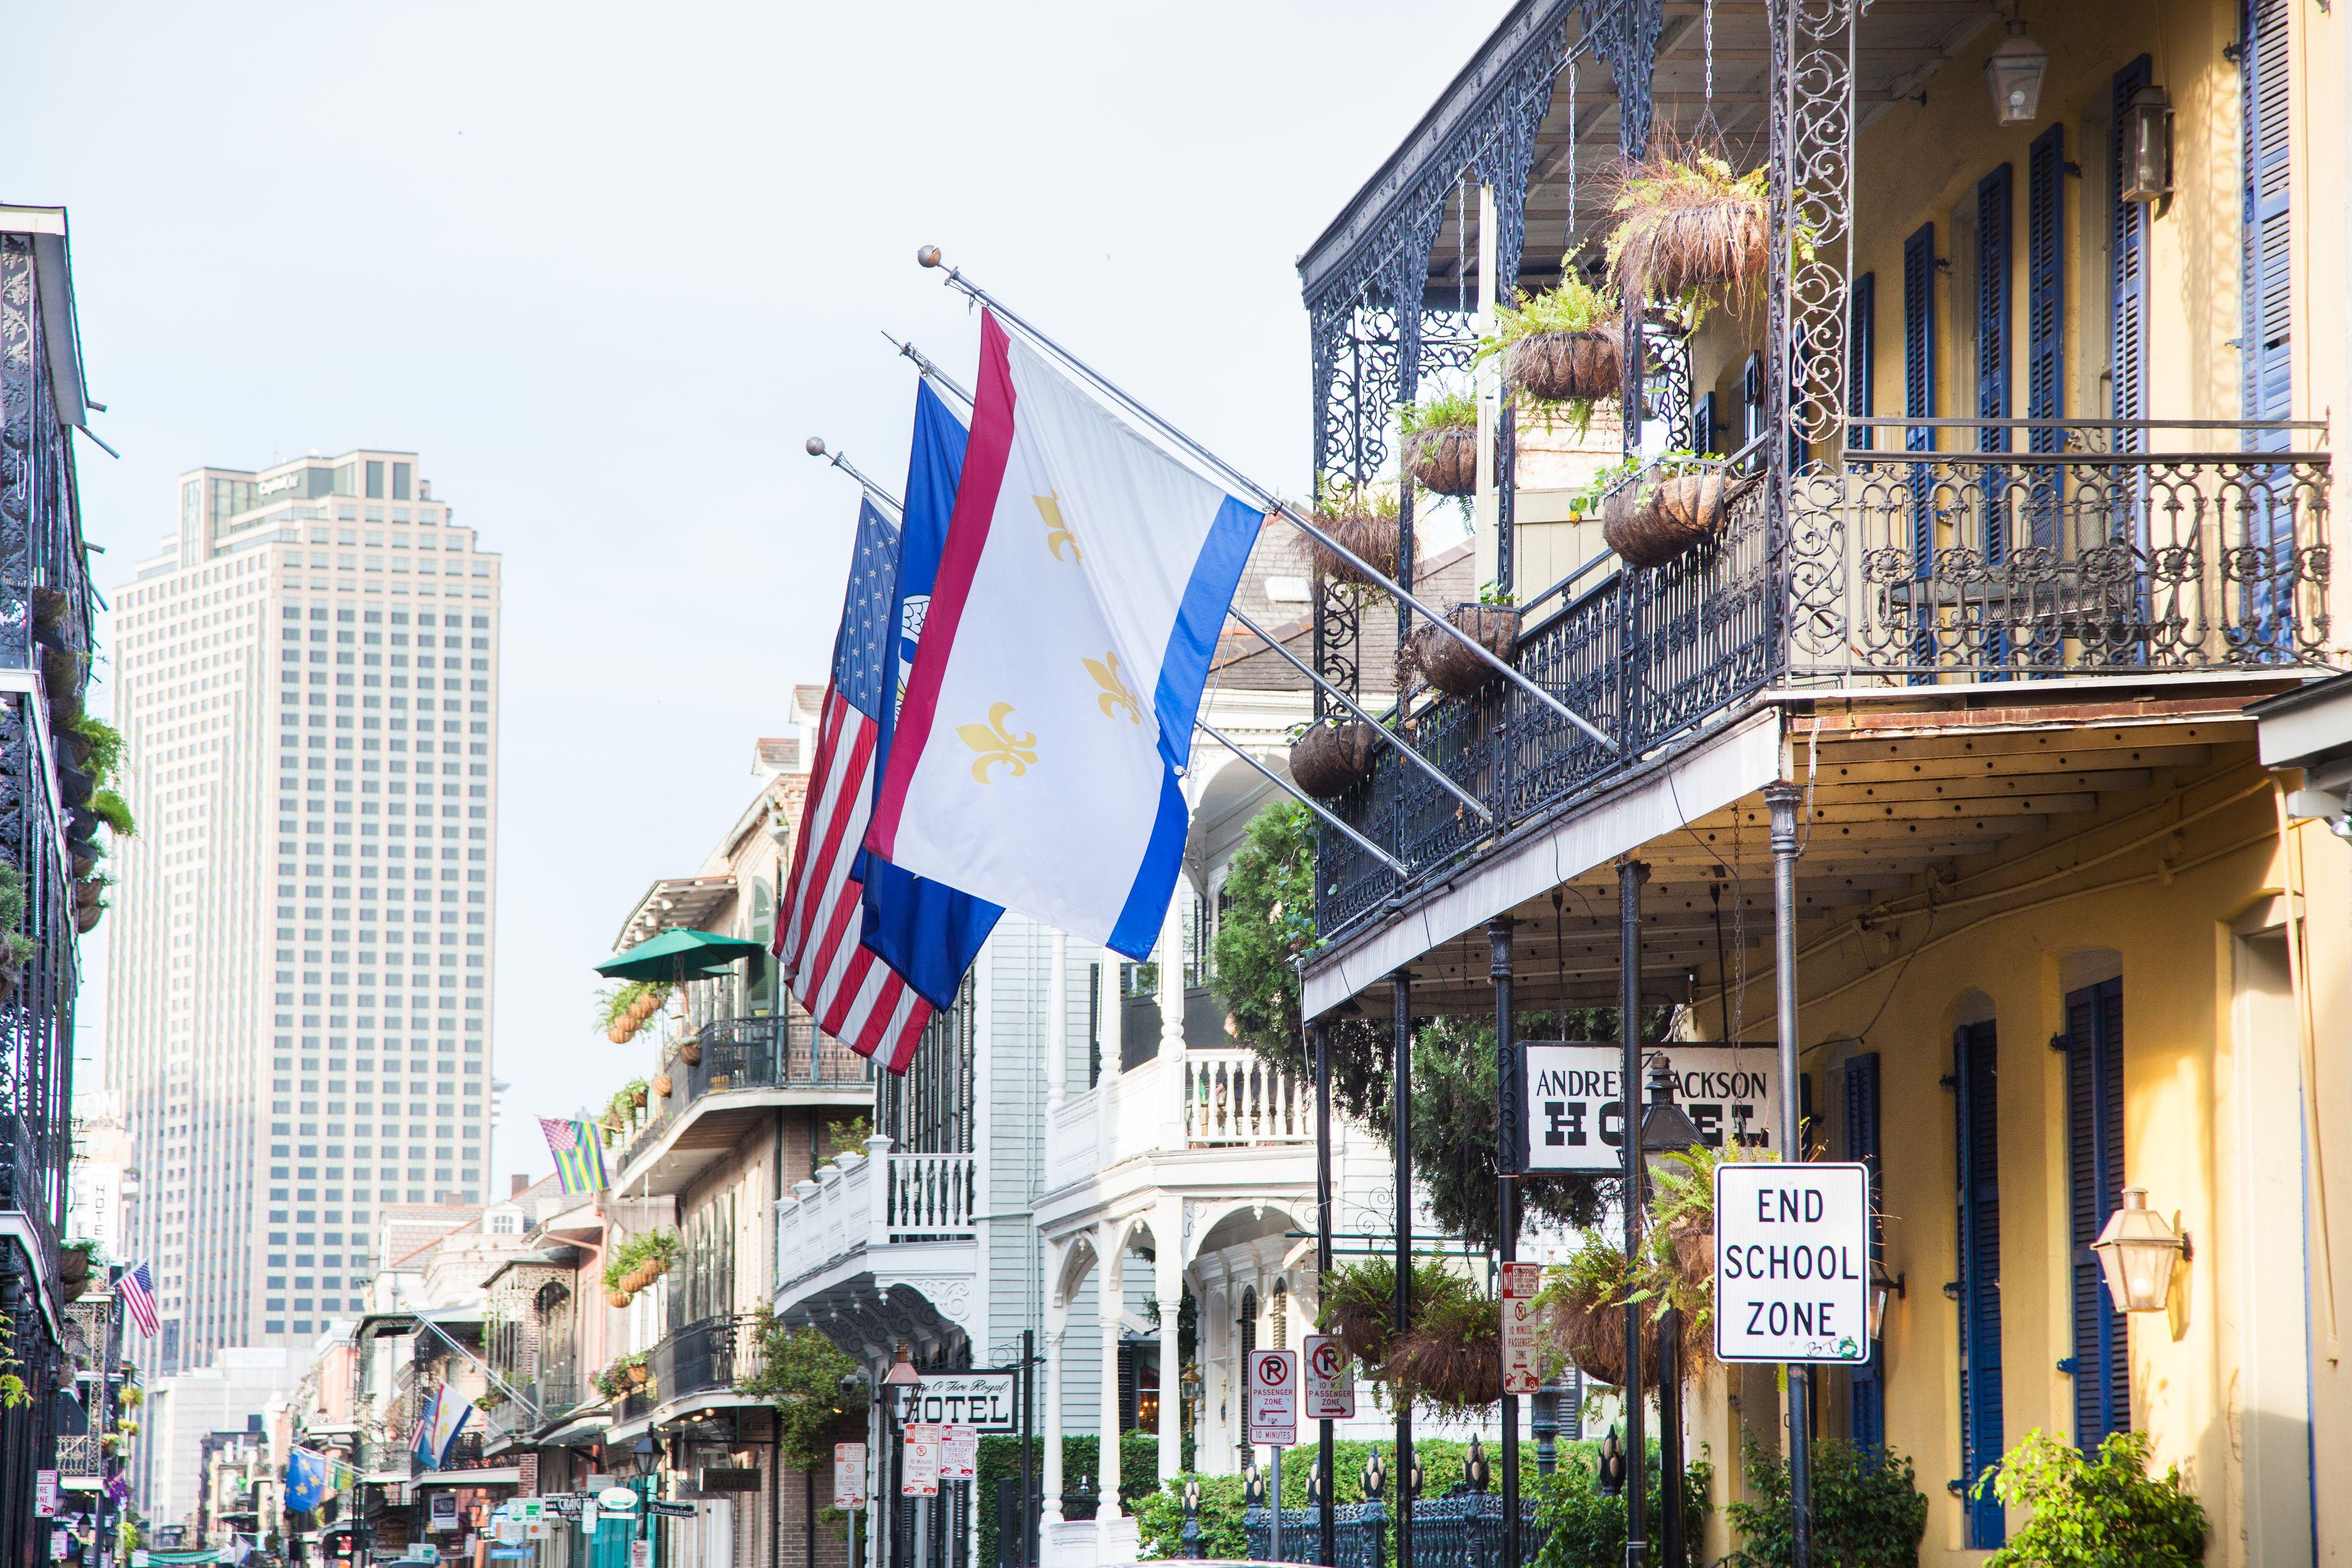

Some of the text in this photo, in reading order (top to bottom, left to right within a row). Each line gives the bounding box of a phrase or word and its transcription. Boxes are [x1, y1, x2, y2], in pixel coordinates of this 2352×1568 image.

[1536, 1068, 1766, 1100] ANDRE ACKSON
[1544, 1101, 1769, 1148] HOEL
[94, 1184, 105, 1236] HOTE
[1758, 1189, 1823, 1223] END
[1724, 1244, 1859, 1280] SCHOOL
[1504, 1268, 1537, 1290] NO STOPPING
[1746, 1301, 1836, 1336] ZONE
[1509, 1325, 1532, 1335] 10 MINUTE
[1515, 1350, 1526, 1359] ZONE
[970, 1379, 1009, 1395] Royal
[902, 1395, 1009, 1424] HOTEL
[906, 1428, 914, 1439] NO
[943, 1428, 952, 1439] NO
[1265, 1431, 1291, 1439] MINUTES
[559, 1498, 582, 1511] CRAIG
[652, 1504, 695, 1518] Dumaine
